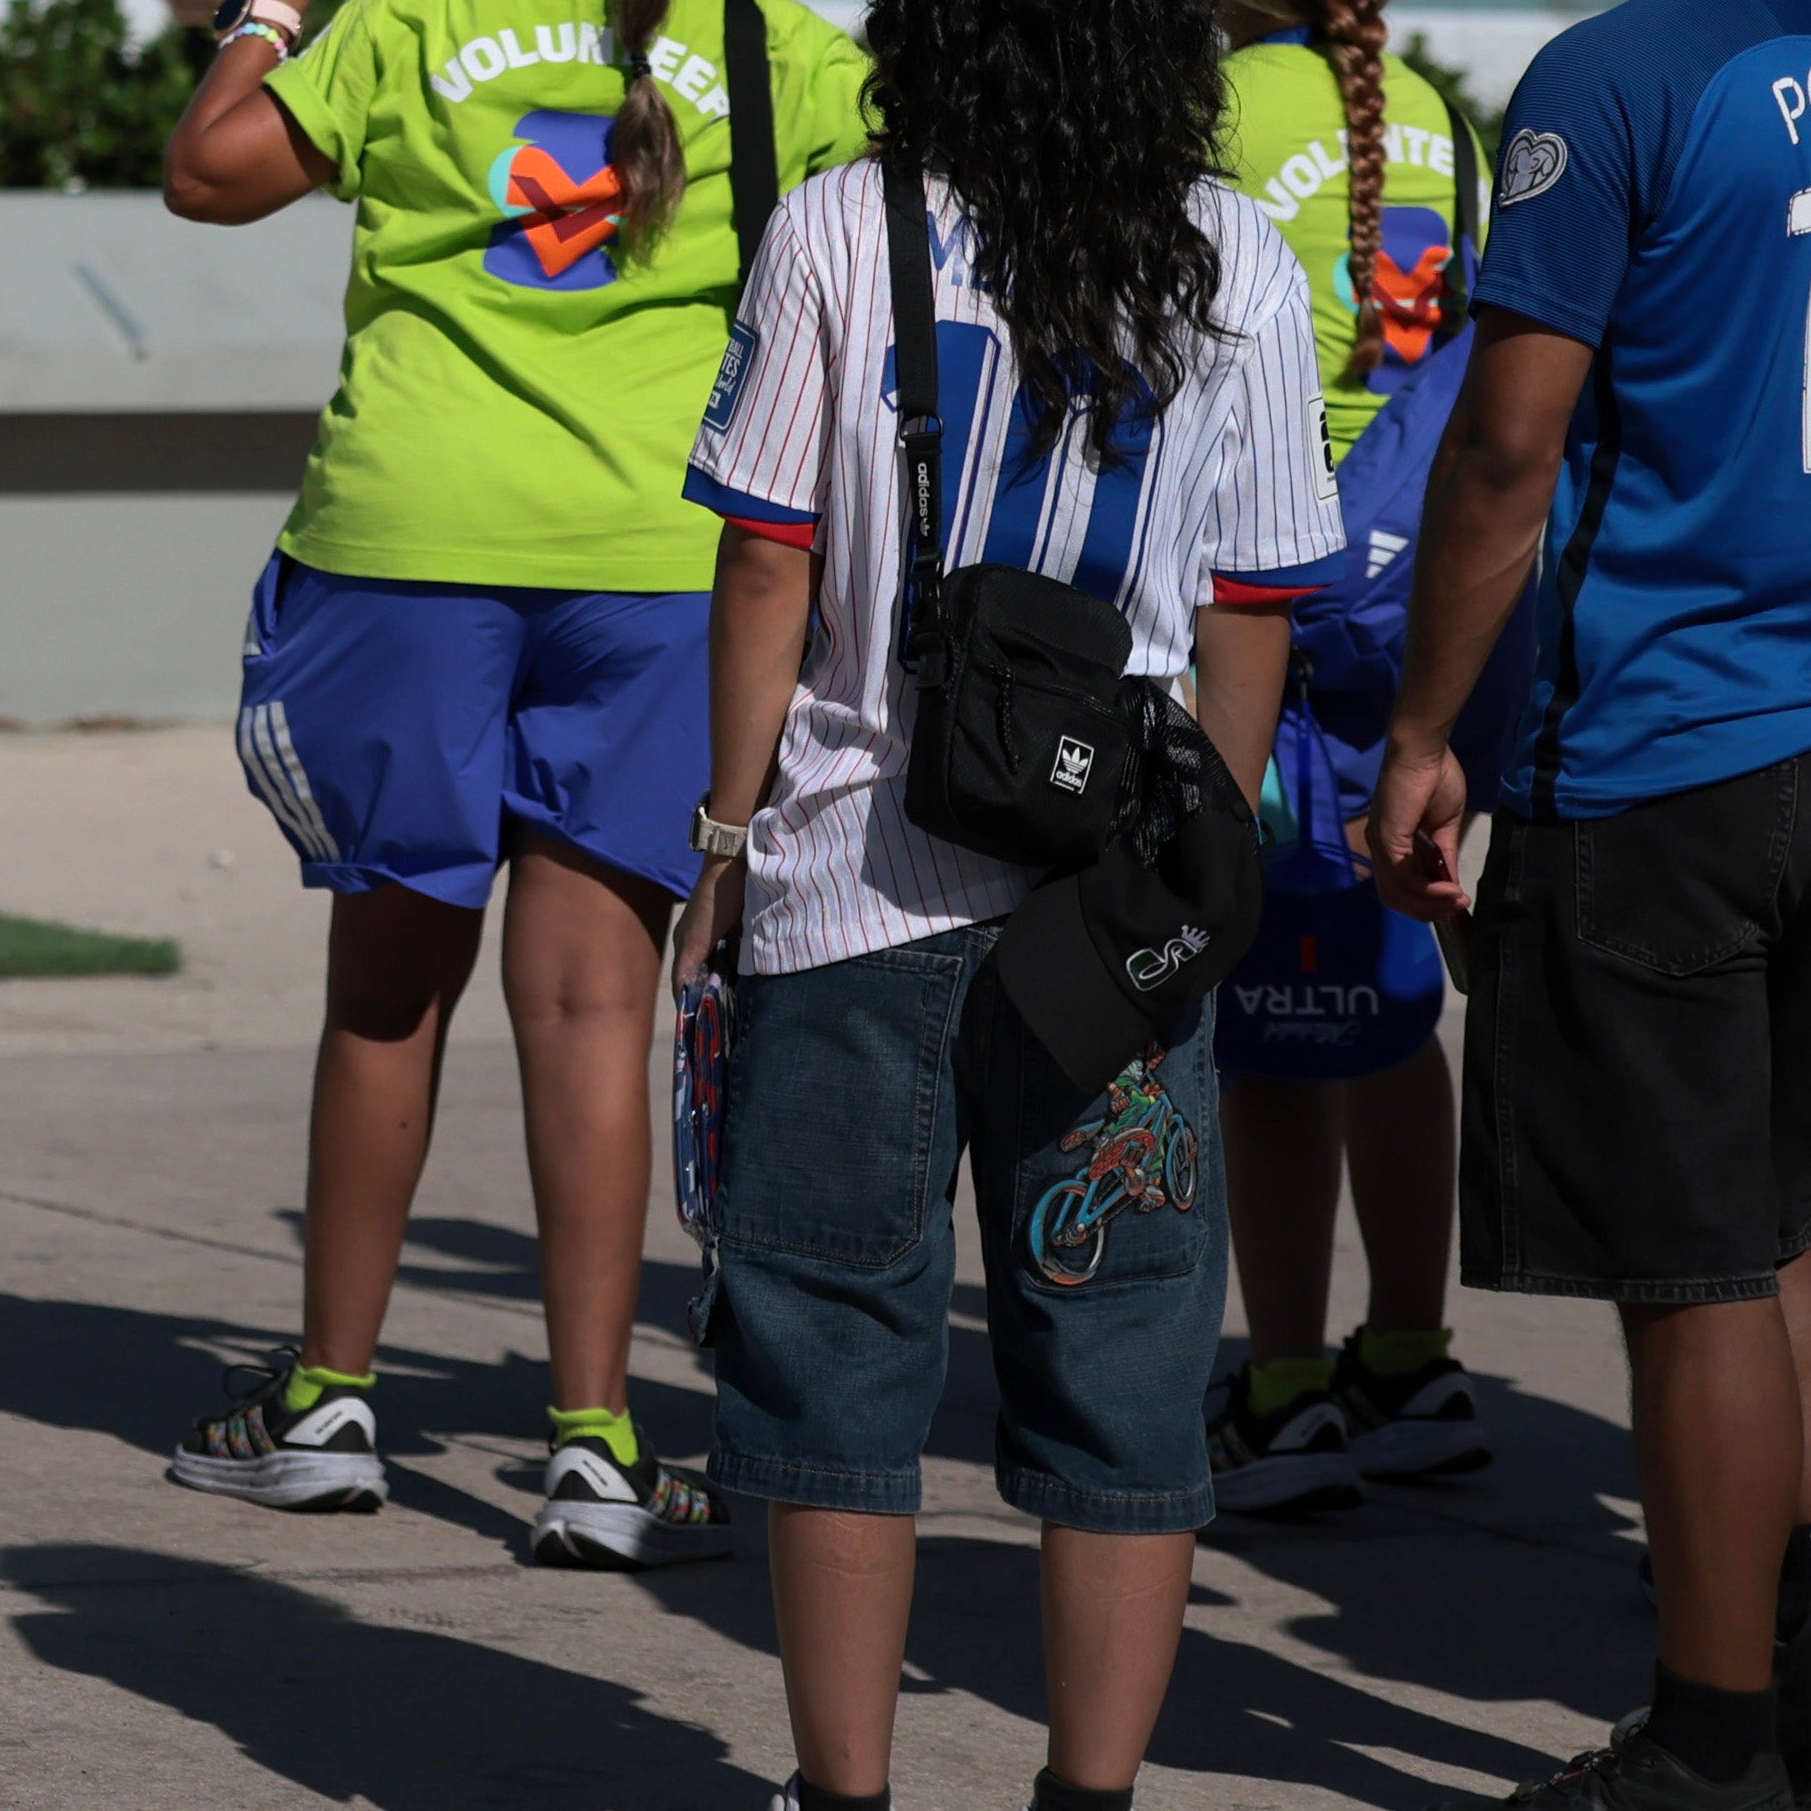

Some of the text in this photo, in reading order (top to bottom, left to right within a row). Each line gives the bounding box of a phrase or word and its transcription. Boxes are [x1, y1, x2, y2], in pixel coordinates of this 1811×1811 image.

[430, 21, 729, 117] VOLUNEER
[918, 462, 930, 517] adidas
[1056, 770, 1083, 788] adidas
[1234, 984, 1379, 1016] ULTRA
